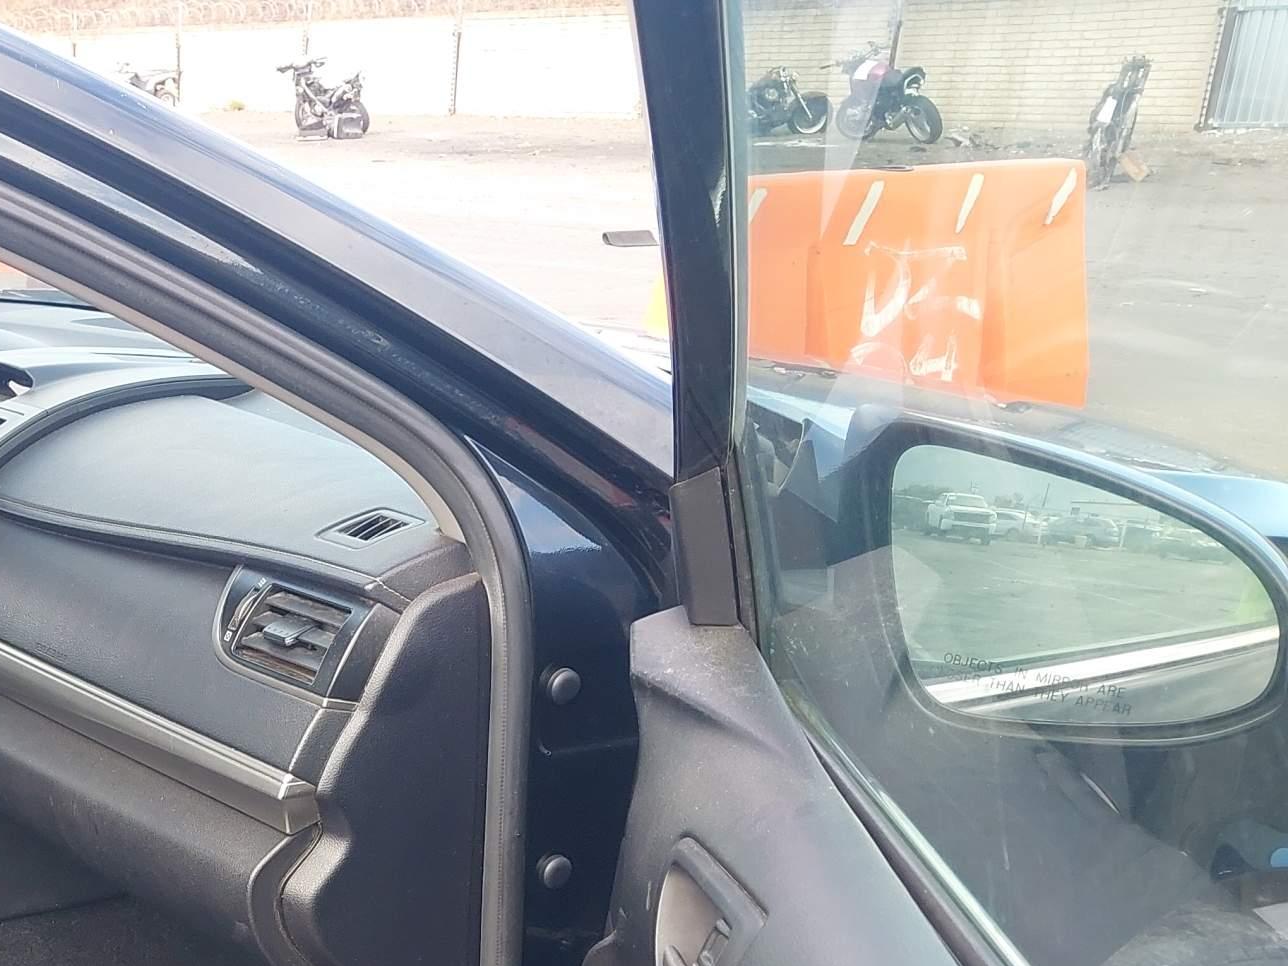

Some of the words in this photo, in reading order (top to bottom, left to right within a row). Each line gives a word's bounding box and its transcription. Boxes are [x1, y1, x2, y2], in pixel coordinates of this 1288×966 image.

[943, 652, 1002, 675] OBJECTS
[1015, 666, 1028, 680] IN
[1097, 684, 1127, 698] ARE
[990, 678, 1026, 695] THAN
[1075, 695, 1132, 716] APPEAR
